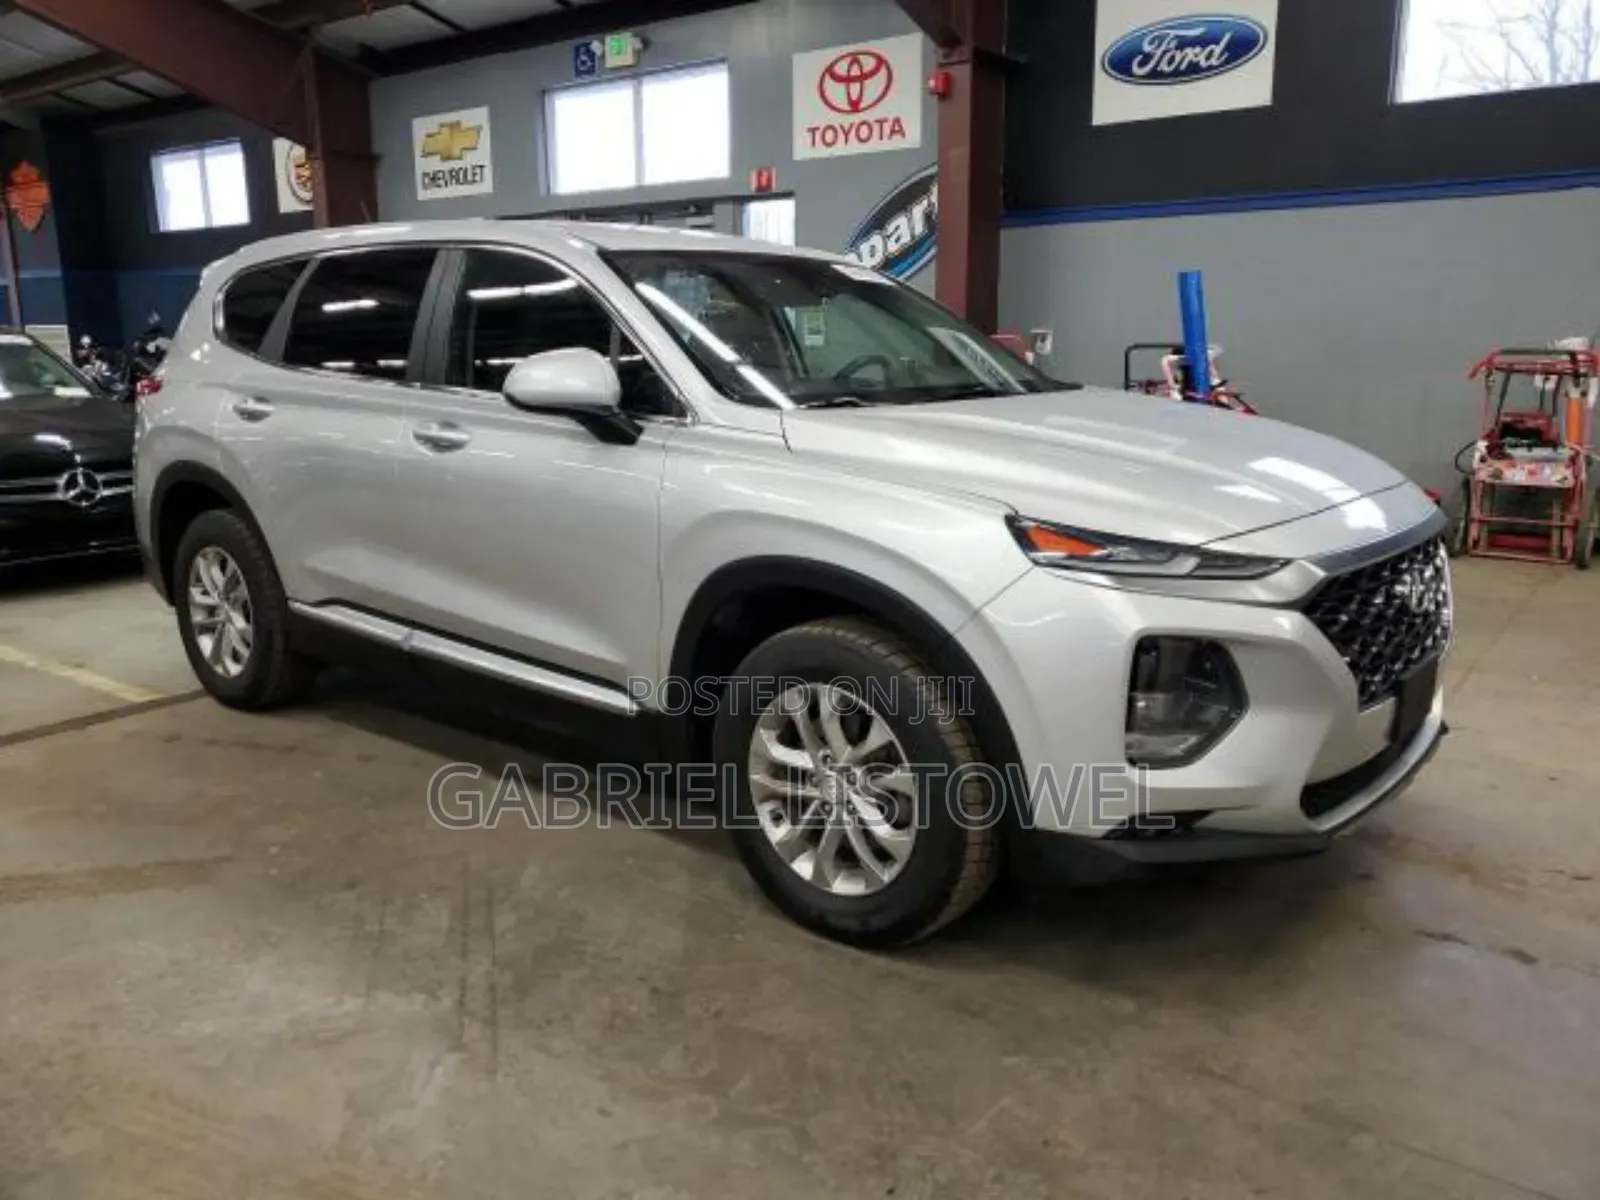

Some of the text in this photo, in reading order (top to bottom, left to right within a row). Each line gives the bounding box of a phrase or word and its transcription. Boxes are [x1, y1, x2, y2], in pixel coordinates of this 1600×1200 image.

[1132, 27, 1233, 76] Ford
[807, 117, 906, 148] TOYOTA
[422, 165, 486, 190] CHEVROLET
